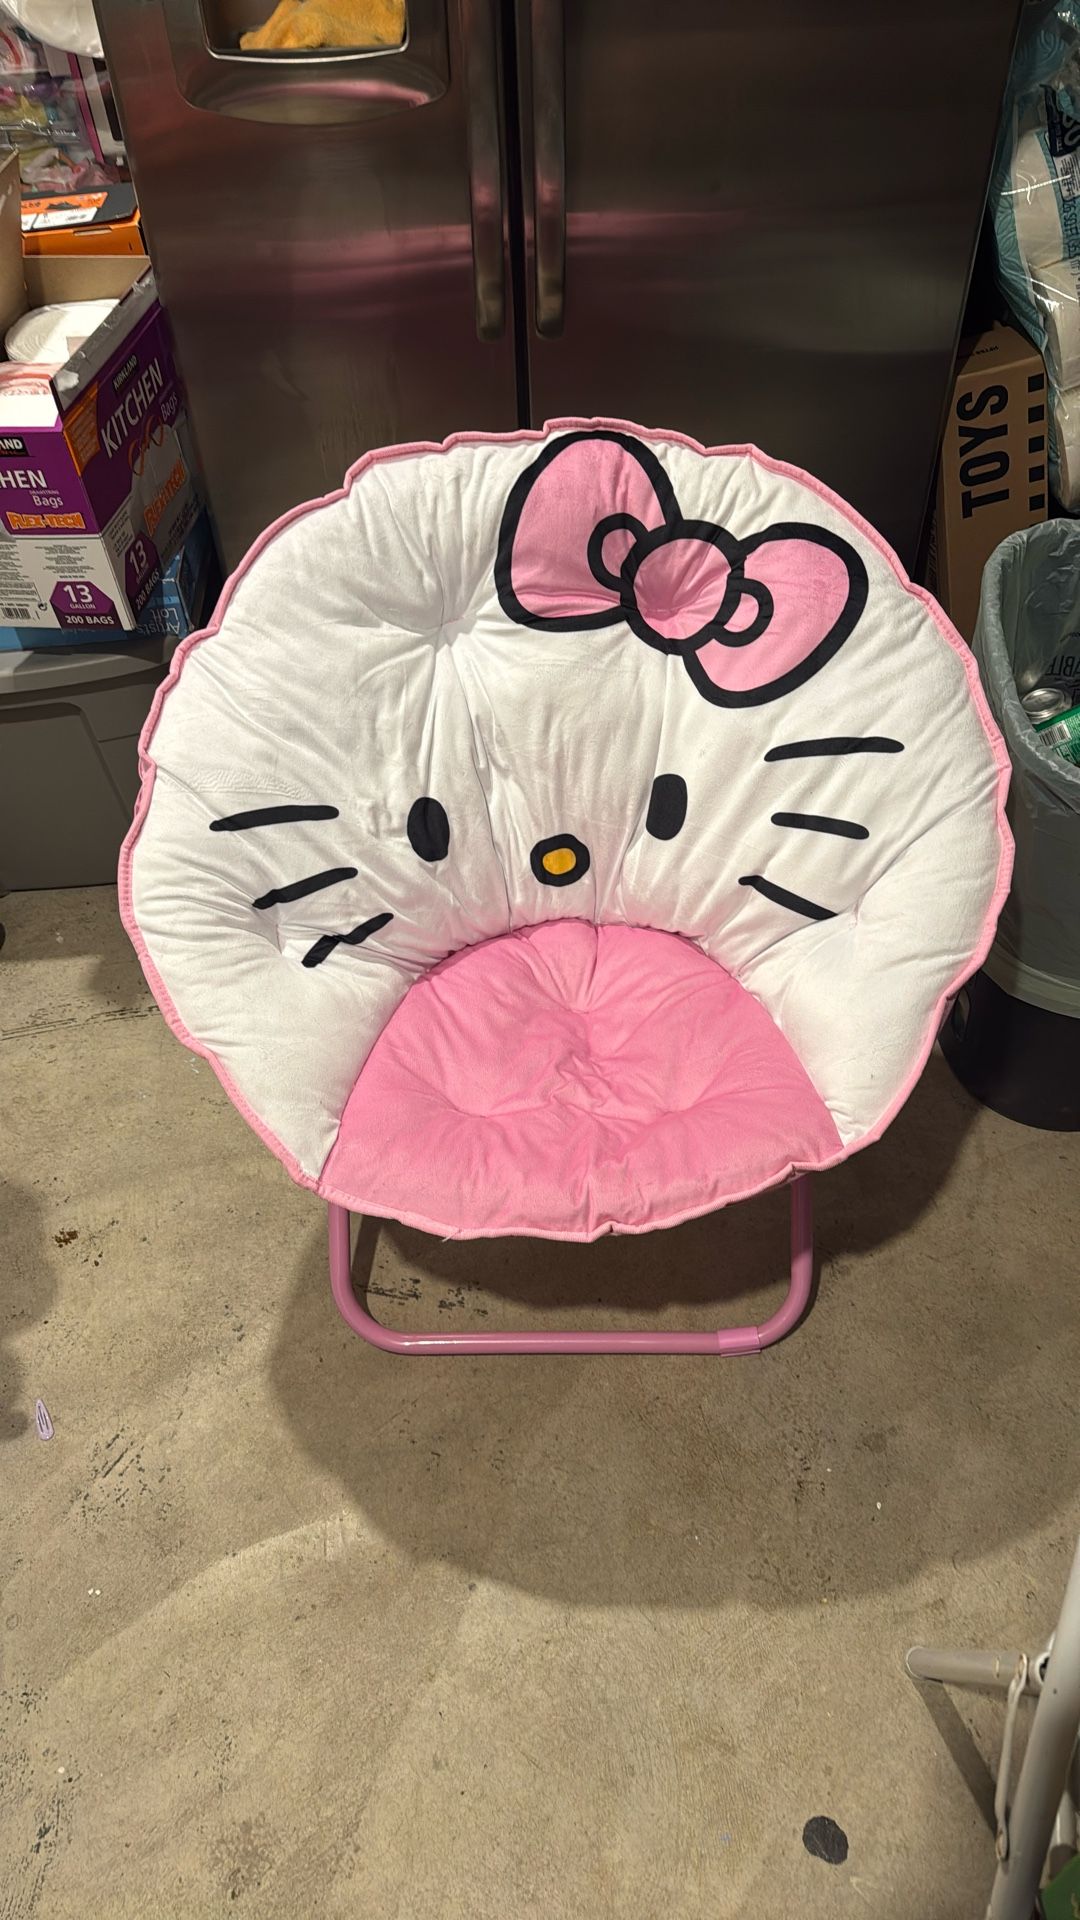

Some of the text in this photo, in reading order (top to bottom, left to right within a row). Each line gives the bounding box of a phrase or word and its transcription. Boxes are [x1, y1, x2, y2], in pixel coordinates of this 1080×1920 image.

[113, 355, 137, 390] KIRKLAND
[101, 357, 164, 459] KITCHEN
[161, 391, 178, 422] Bags
[956, 385, 1010, 519] TOYS
[33, 495, 63, 509] Bags
[6, 511, 86, 530] FLEX-TECH
[130, 540, 148, 575] 13
[63, 584, 93, 603] 13
[135, 567, 160, 611] 200 BAGS
[65, 615, 115, 625] 200 BAGS
[150, 607, 179, 622] Loft
